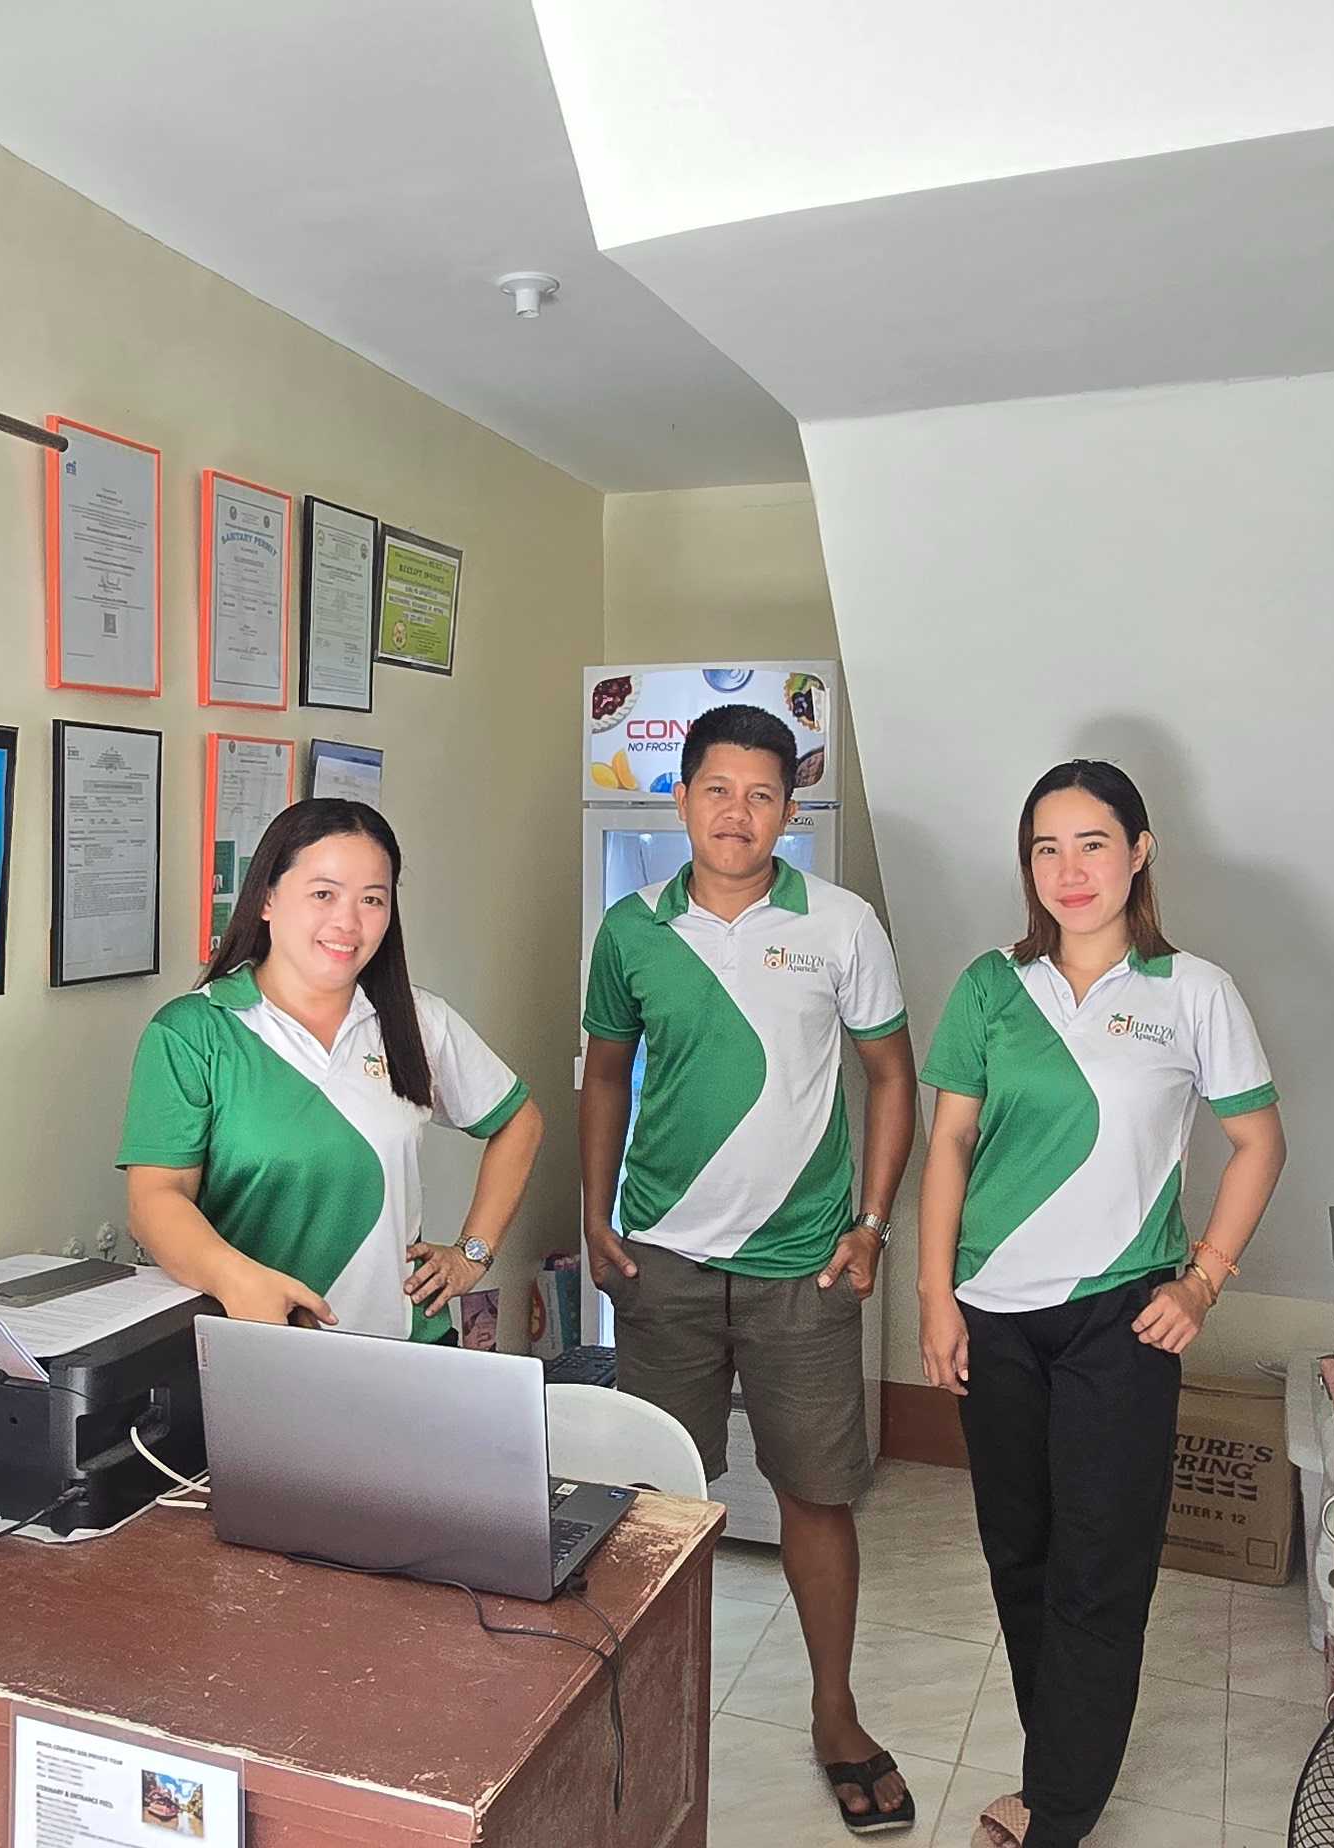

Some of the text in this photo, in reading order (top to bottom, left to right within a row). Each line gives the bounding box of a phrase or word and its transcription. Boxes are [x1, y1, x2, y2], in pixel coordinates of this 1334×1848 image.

[627, 742, 681, 752] NO FROST
[1175, 1433, 1274, 1464] TURE'S
[1172, 1502, 1212, 1518] LITER
[1230, 1512, 1247, 1526] 12
